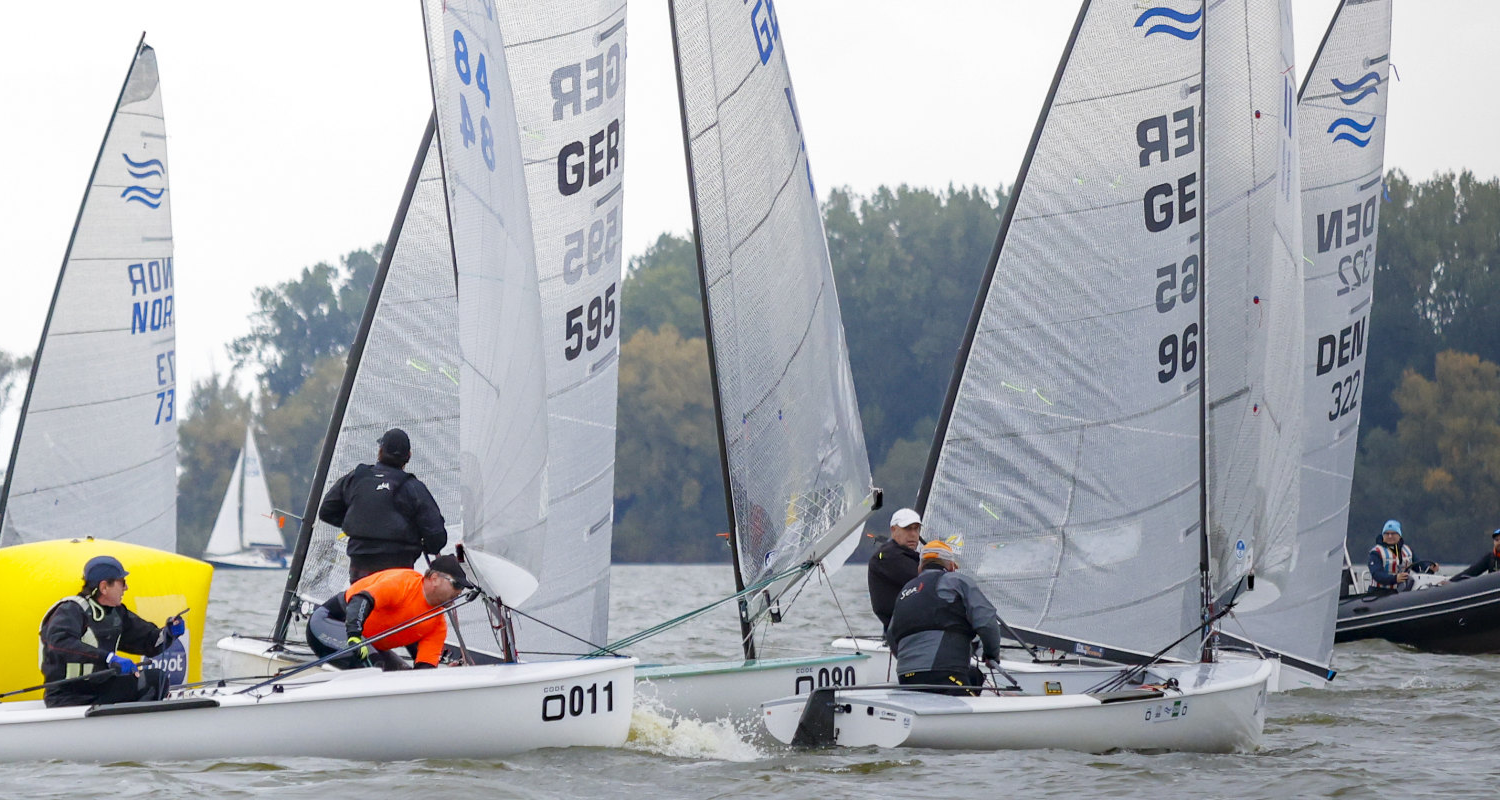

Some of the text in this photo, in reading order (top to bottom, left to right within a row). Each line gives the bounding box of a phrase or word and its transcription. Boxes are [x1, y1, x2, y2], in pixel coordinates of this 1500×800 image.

[453, 29, 491, 109] 84
[557, 118, 619, 197] GER
[1143, 172, 1197, 233] GE
[131, 295, 173, 335] NOR
[564, 282, 617, 362] 595
[1157, 322, 1199, 384] 96
[1315, 316, 1366, 377] DEN
[154, 388, 175, 425] 73
[1328, 369, 1361, 422] 322
[544, 685, 565, 693] CODE
[569, 680, 613, 717] 011
